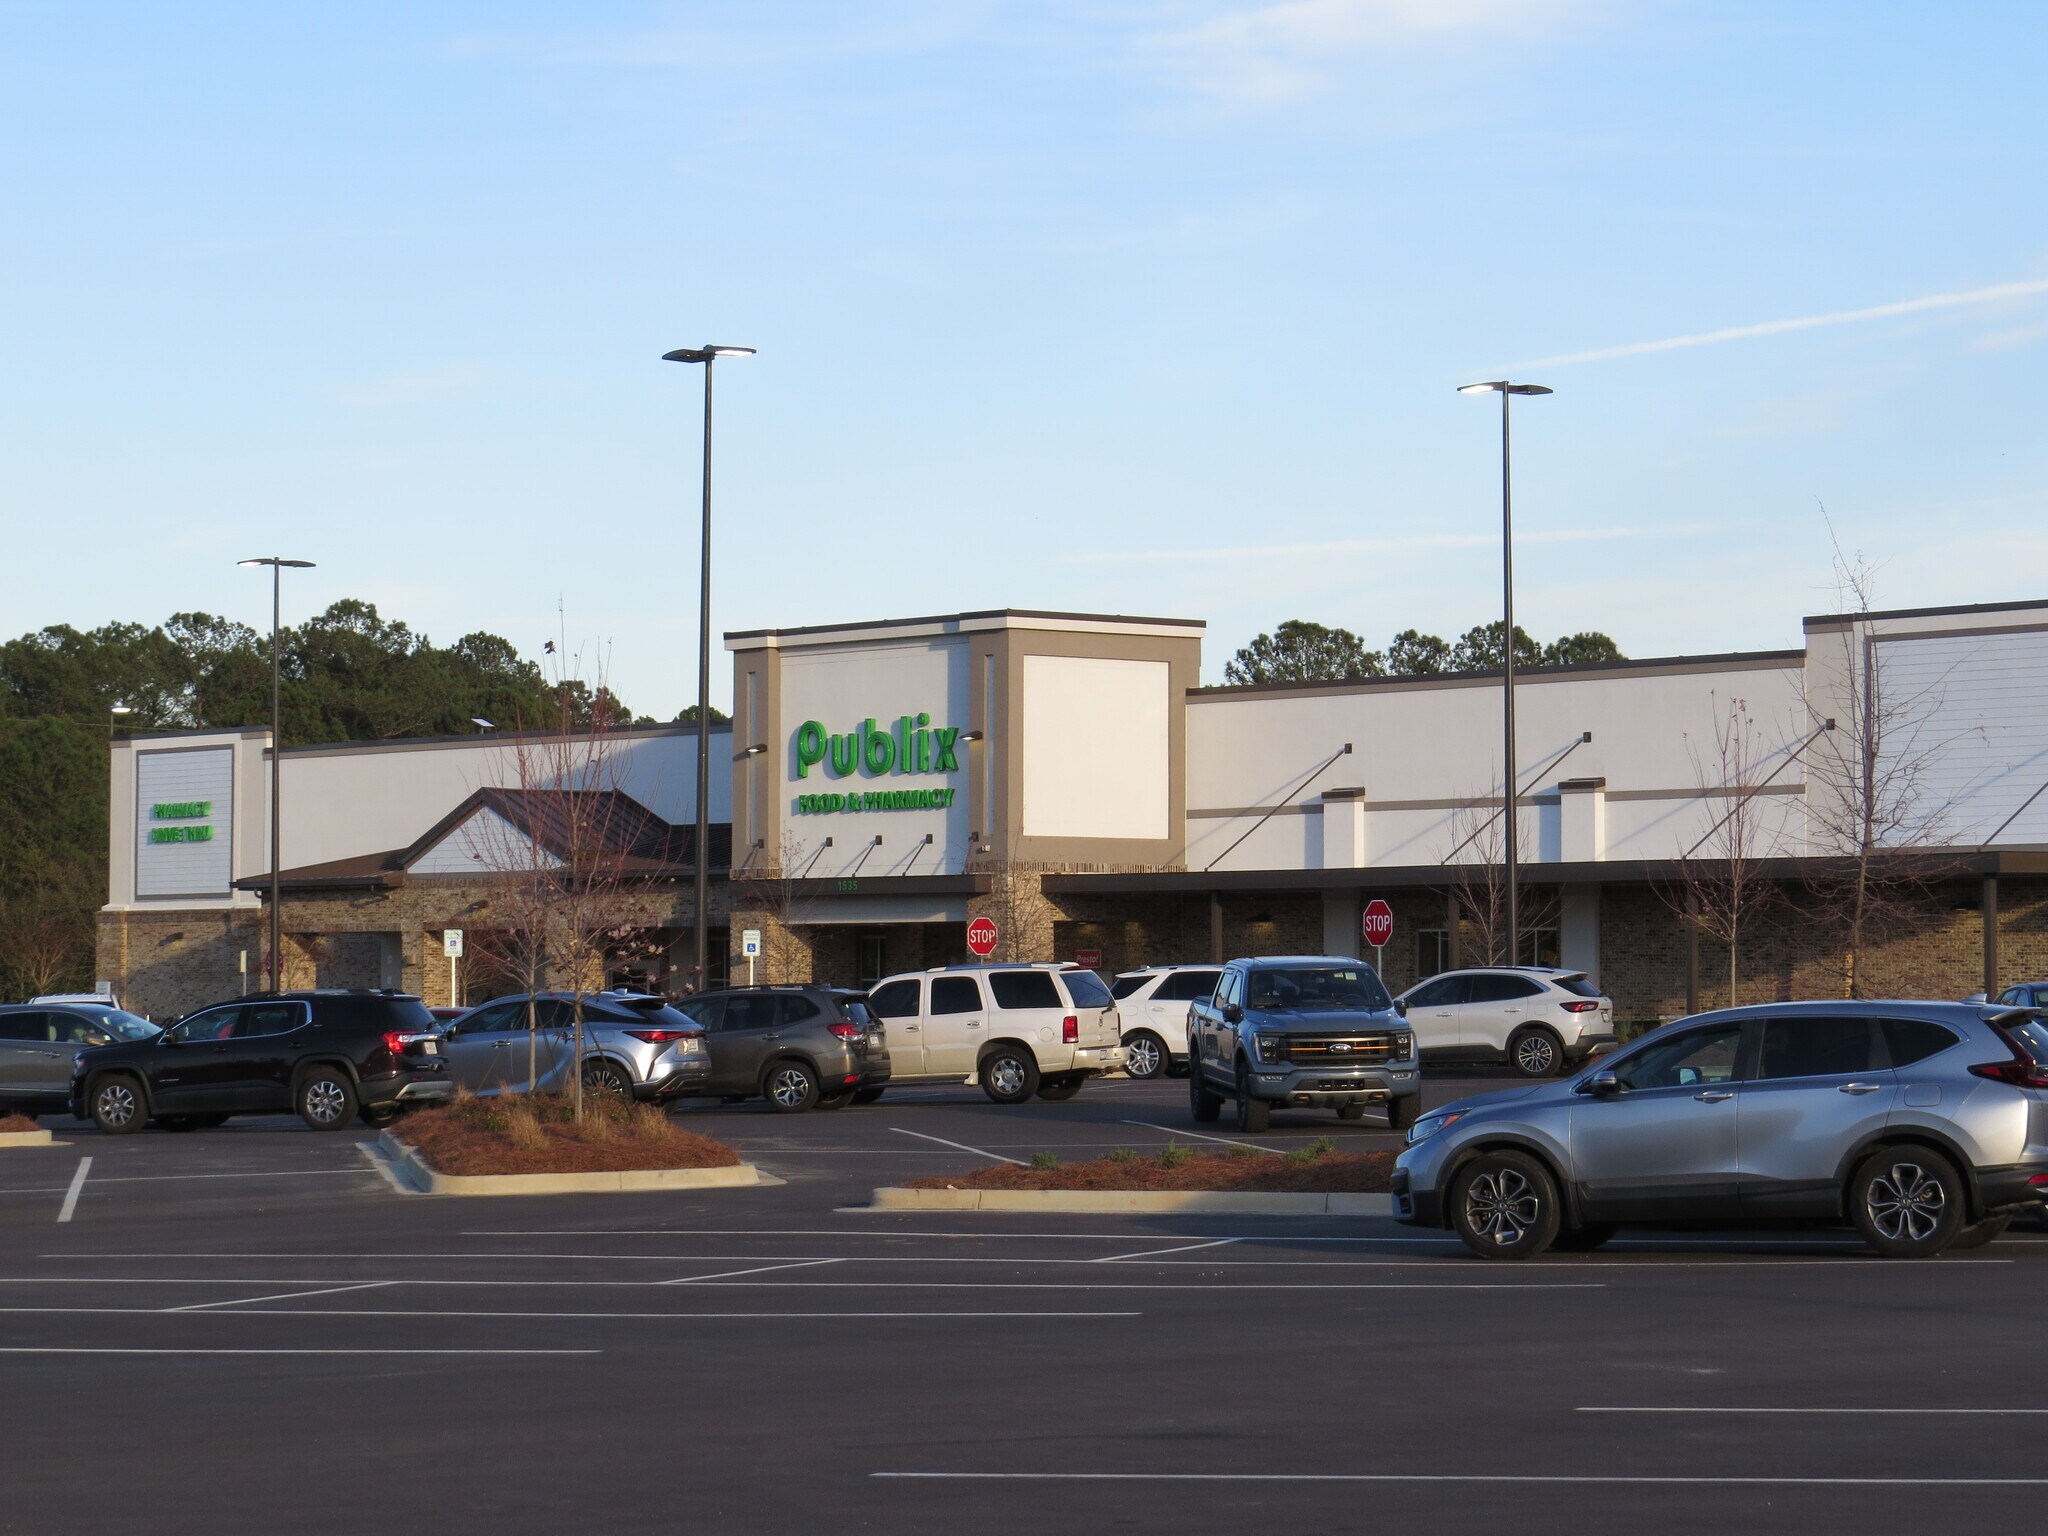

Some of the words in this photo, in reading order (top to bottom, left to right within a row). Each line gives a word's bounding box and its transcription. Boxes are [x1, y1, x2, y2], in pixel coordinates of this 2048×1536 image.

[797, 712, 960, 778] Publix
[799, 793, 845, 814] FOOD
[848, 792, 862, 812] &
[864, 788, 956, 810] PHARMACY
[838, 880, 858, 892] 1535
[1365, 915, 1391, 932] STOP
[970, 929, 996, 944] STOP
